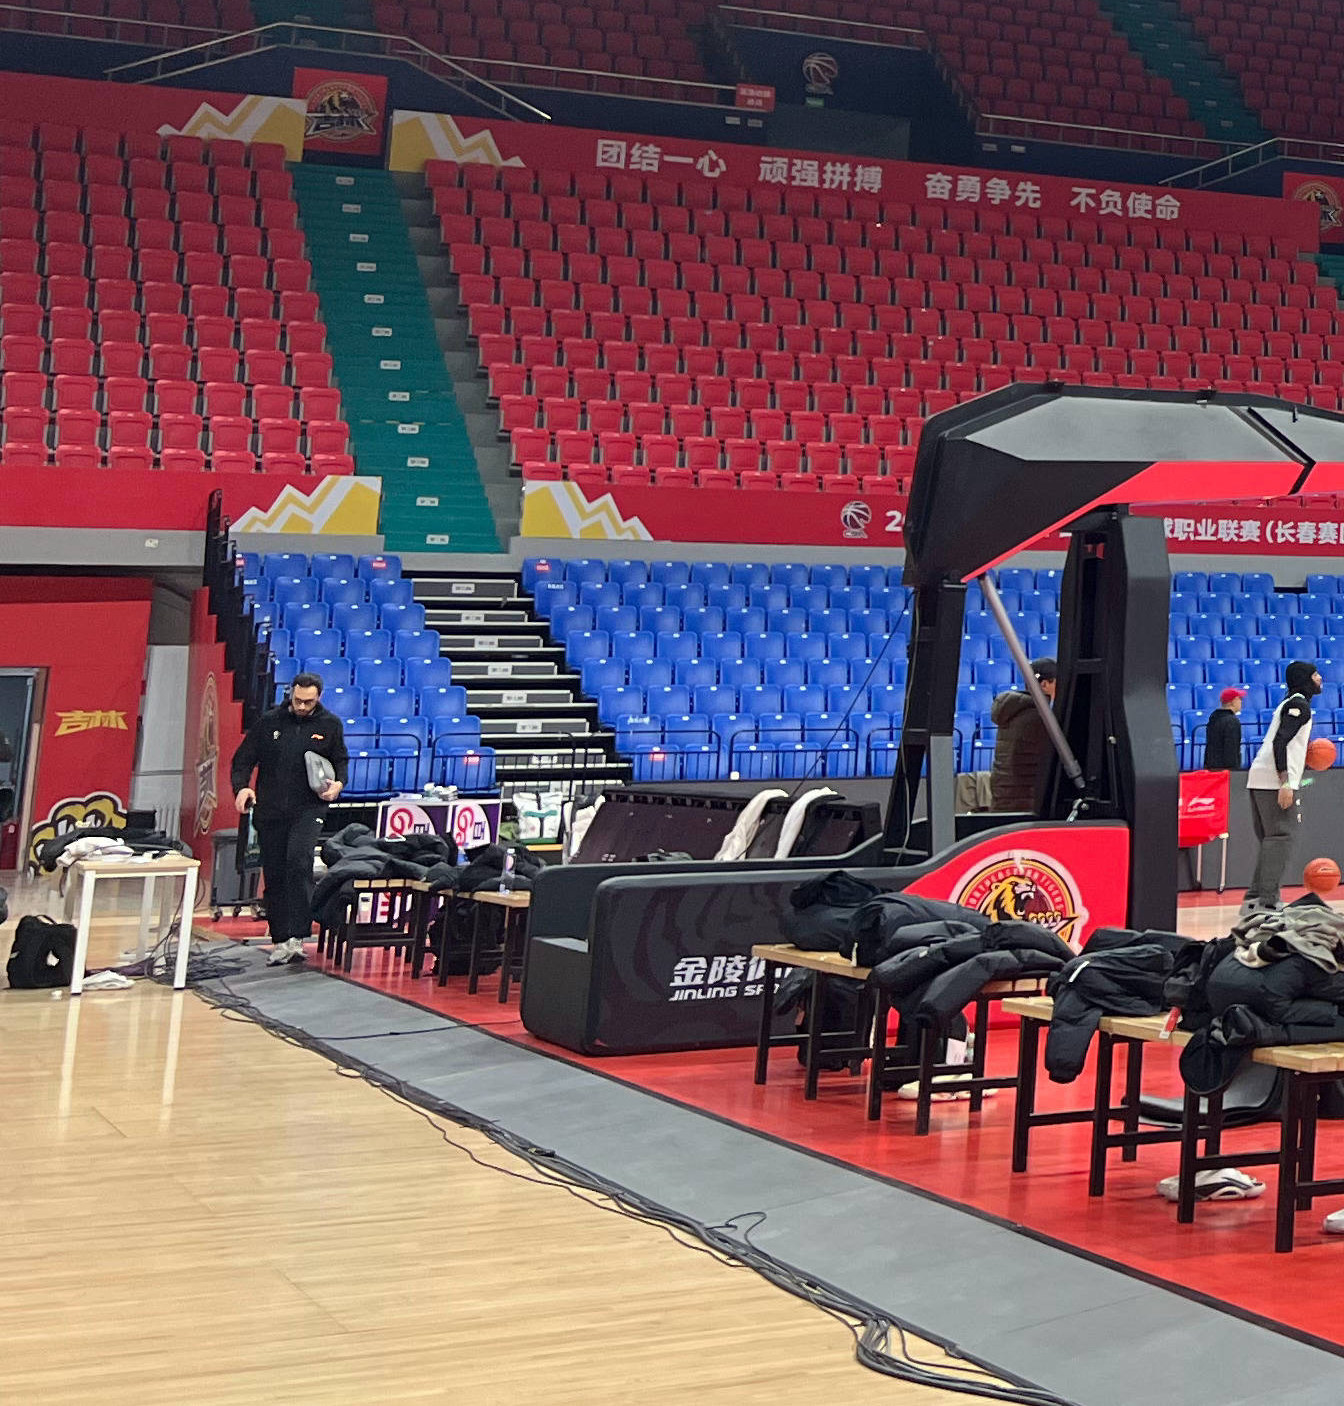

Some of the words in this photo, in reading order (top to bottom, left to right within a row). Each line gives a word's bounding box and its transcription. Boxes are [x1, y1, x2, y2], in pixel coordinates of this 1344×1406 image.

[596, 139, 727, 178] 团结一心
[758, 156, 884, 194] 顽强拼搏
[925, 172, 1042, 208] 奋勇争先
[1070, 186, 1181, 221] 不负使命
[55, 710, 128, 737] 吉林
[668, 985, 738, 1002] JINLING
